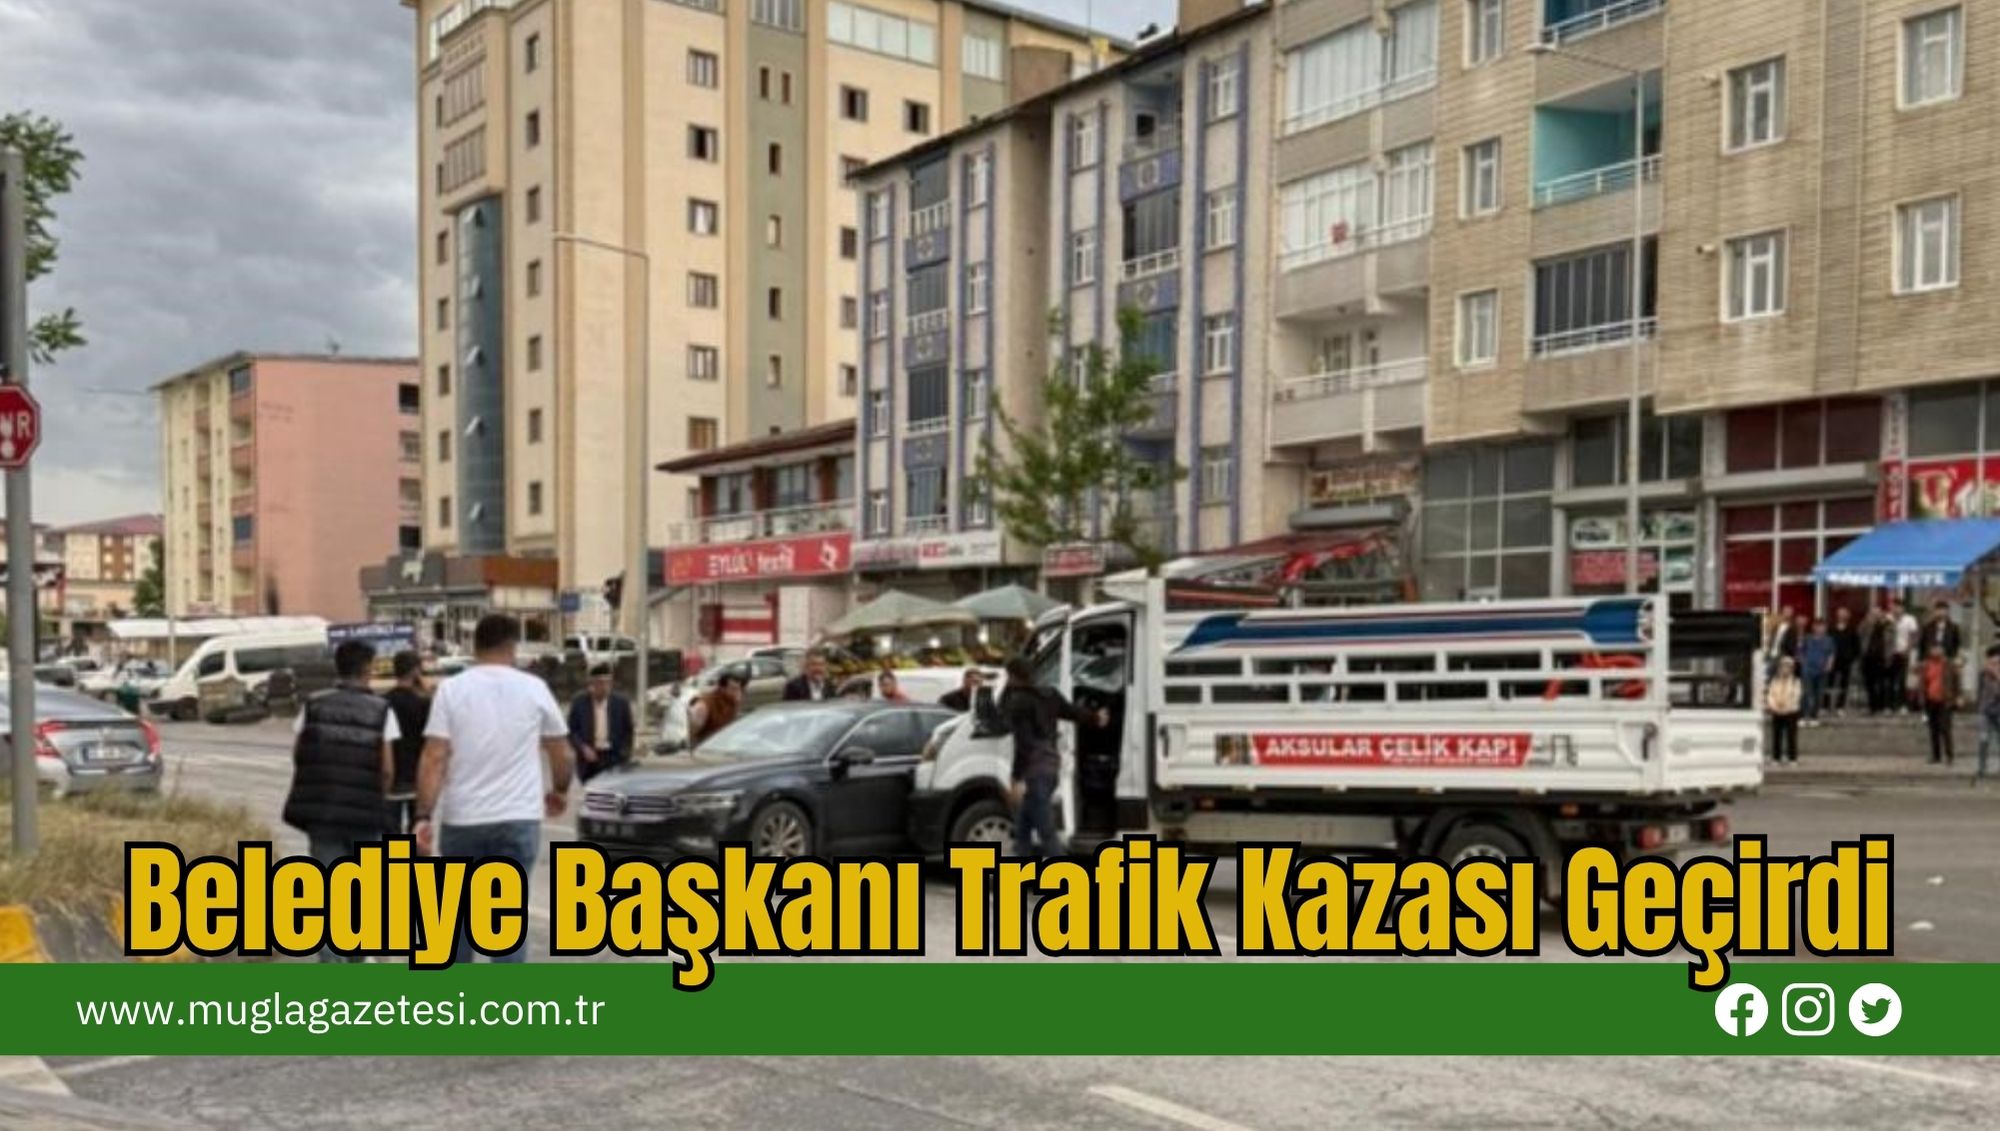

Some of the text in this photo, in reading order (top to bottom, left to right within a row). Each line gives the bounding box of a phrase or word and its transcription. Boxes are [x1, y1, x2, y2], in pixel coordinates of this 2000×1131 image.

[1265, 734, 1517, 760] AKSULAR ÇELİK KAPI
